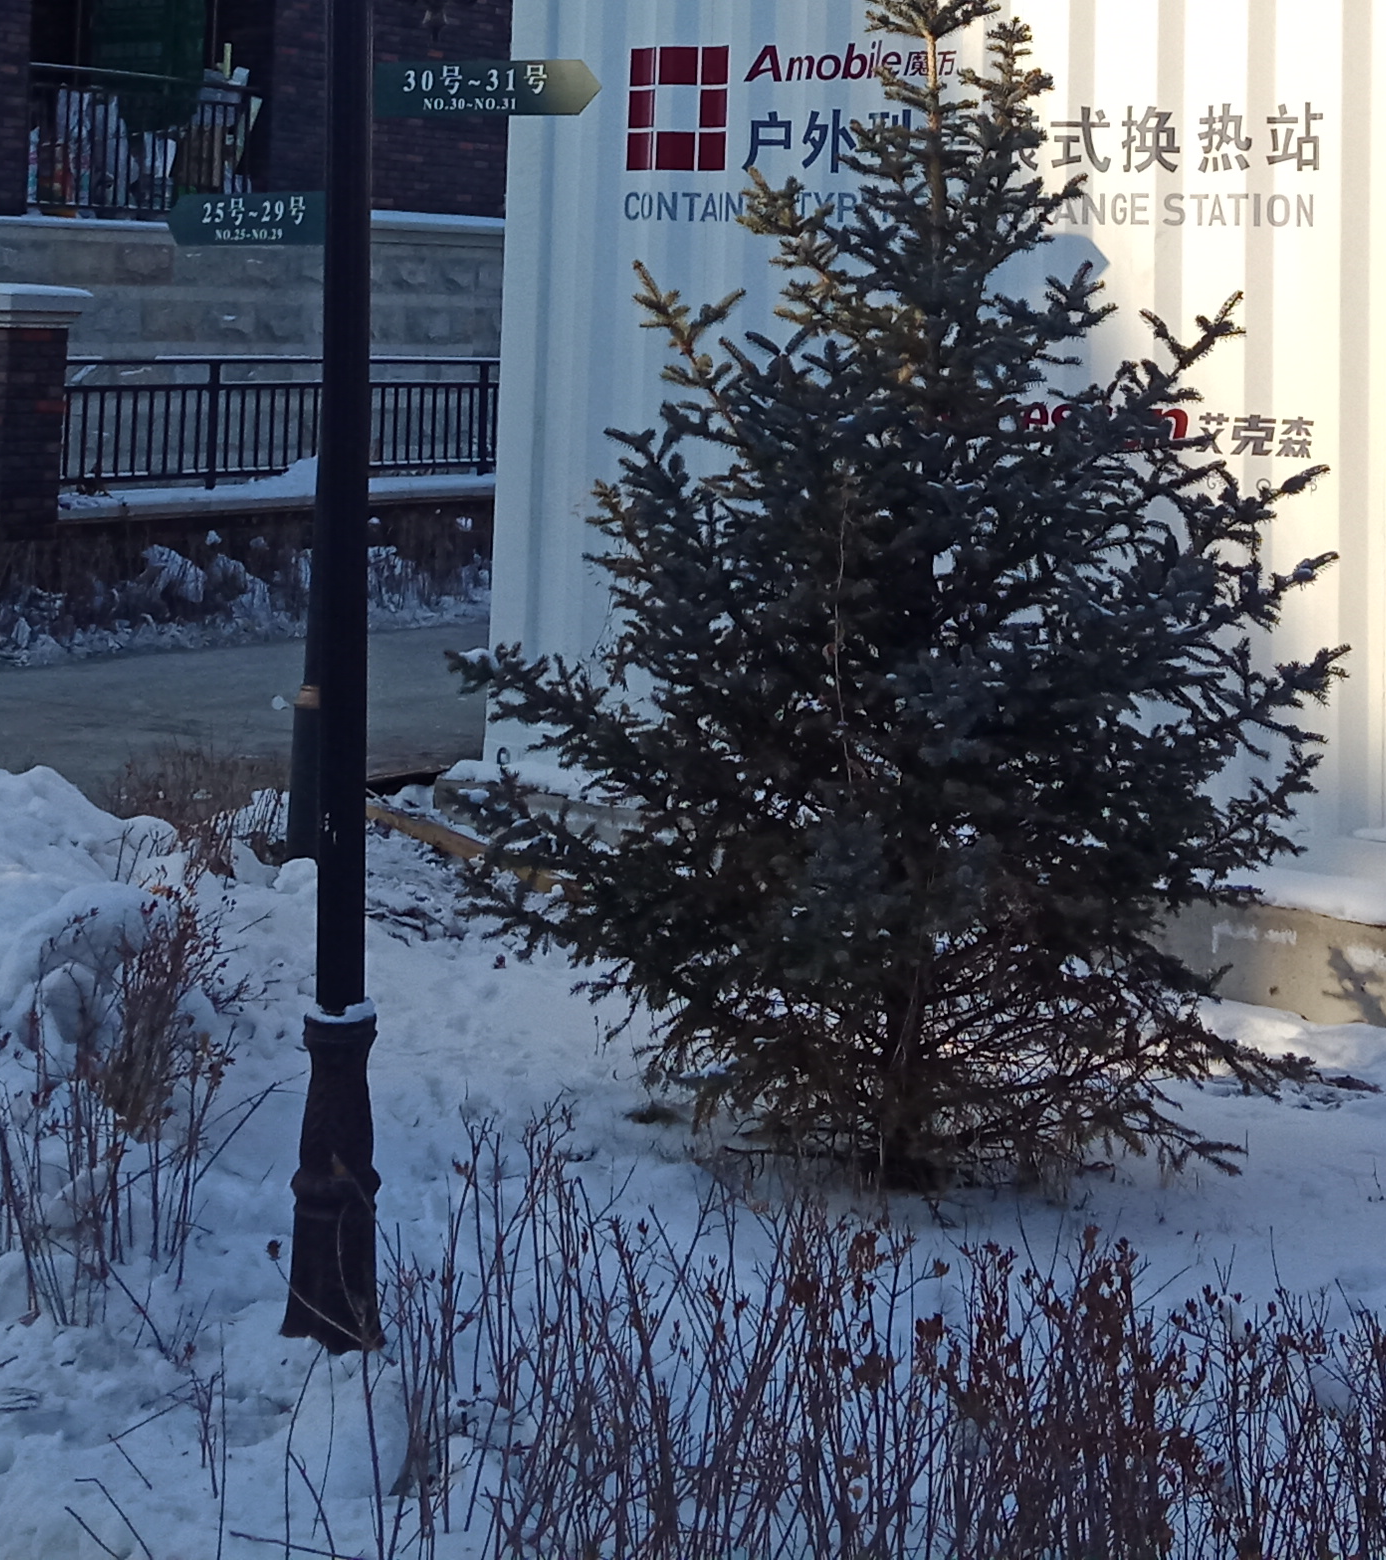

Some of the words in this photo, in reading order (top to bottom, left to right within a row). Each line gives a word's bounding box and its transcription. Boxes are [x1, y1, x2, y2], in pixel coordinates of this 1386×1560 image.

[744, 40, 902, 82] Amobile
[741, 101, 1324, 175] 户外式换热站
[624, 191, 763, 223] CONTAIN
[797, 191, 865, 224] TYP
[1162, 193, 1314, 228] STATION
[1196, 411, 1314, 459] 艾克森
